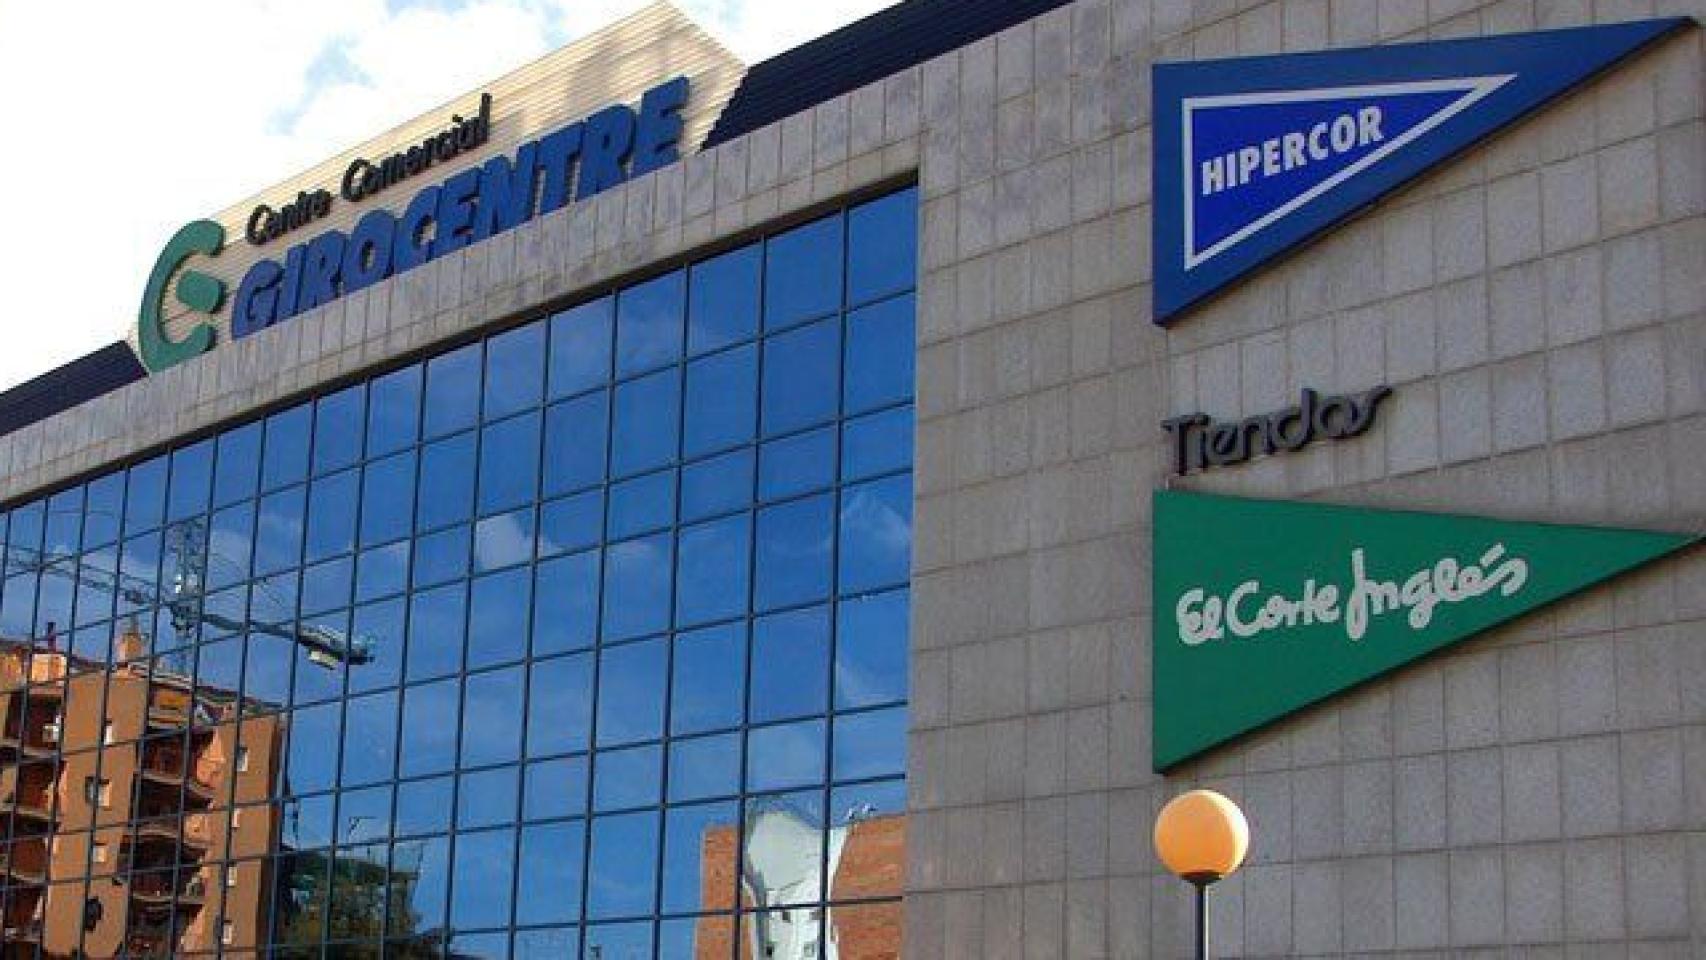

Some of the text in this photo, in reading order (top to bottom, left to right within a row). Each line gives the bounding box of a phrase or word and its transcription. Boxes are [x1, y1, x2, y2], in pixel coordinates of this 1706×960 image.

[341, 93, 492, 202] Comercial
[1202, 106, 1384, 195] HIPERCOR
[231, 76, 690, 340] GIROCENTRE
[1160, 385, 1393, 477] Tiendas
[1176, 543, 1529, 644] El Corte Inglés
